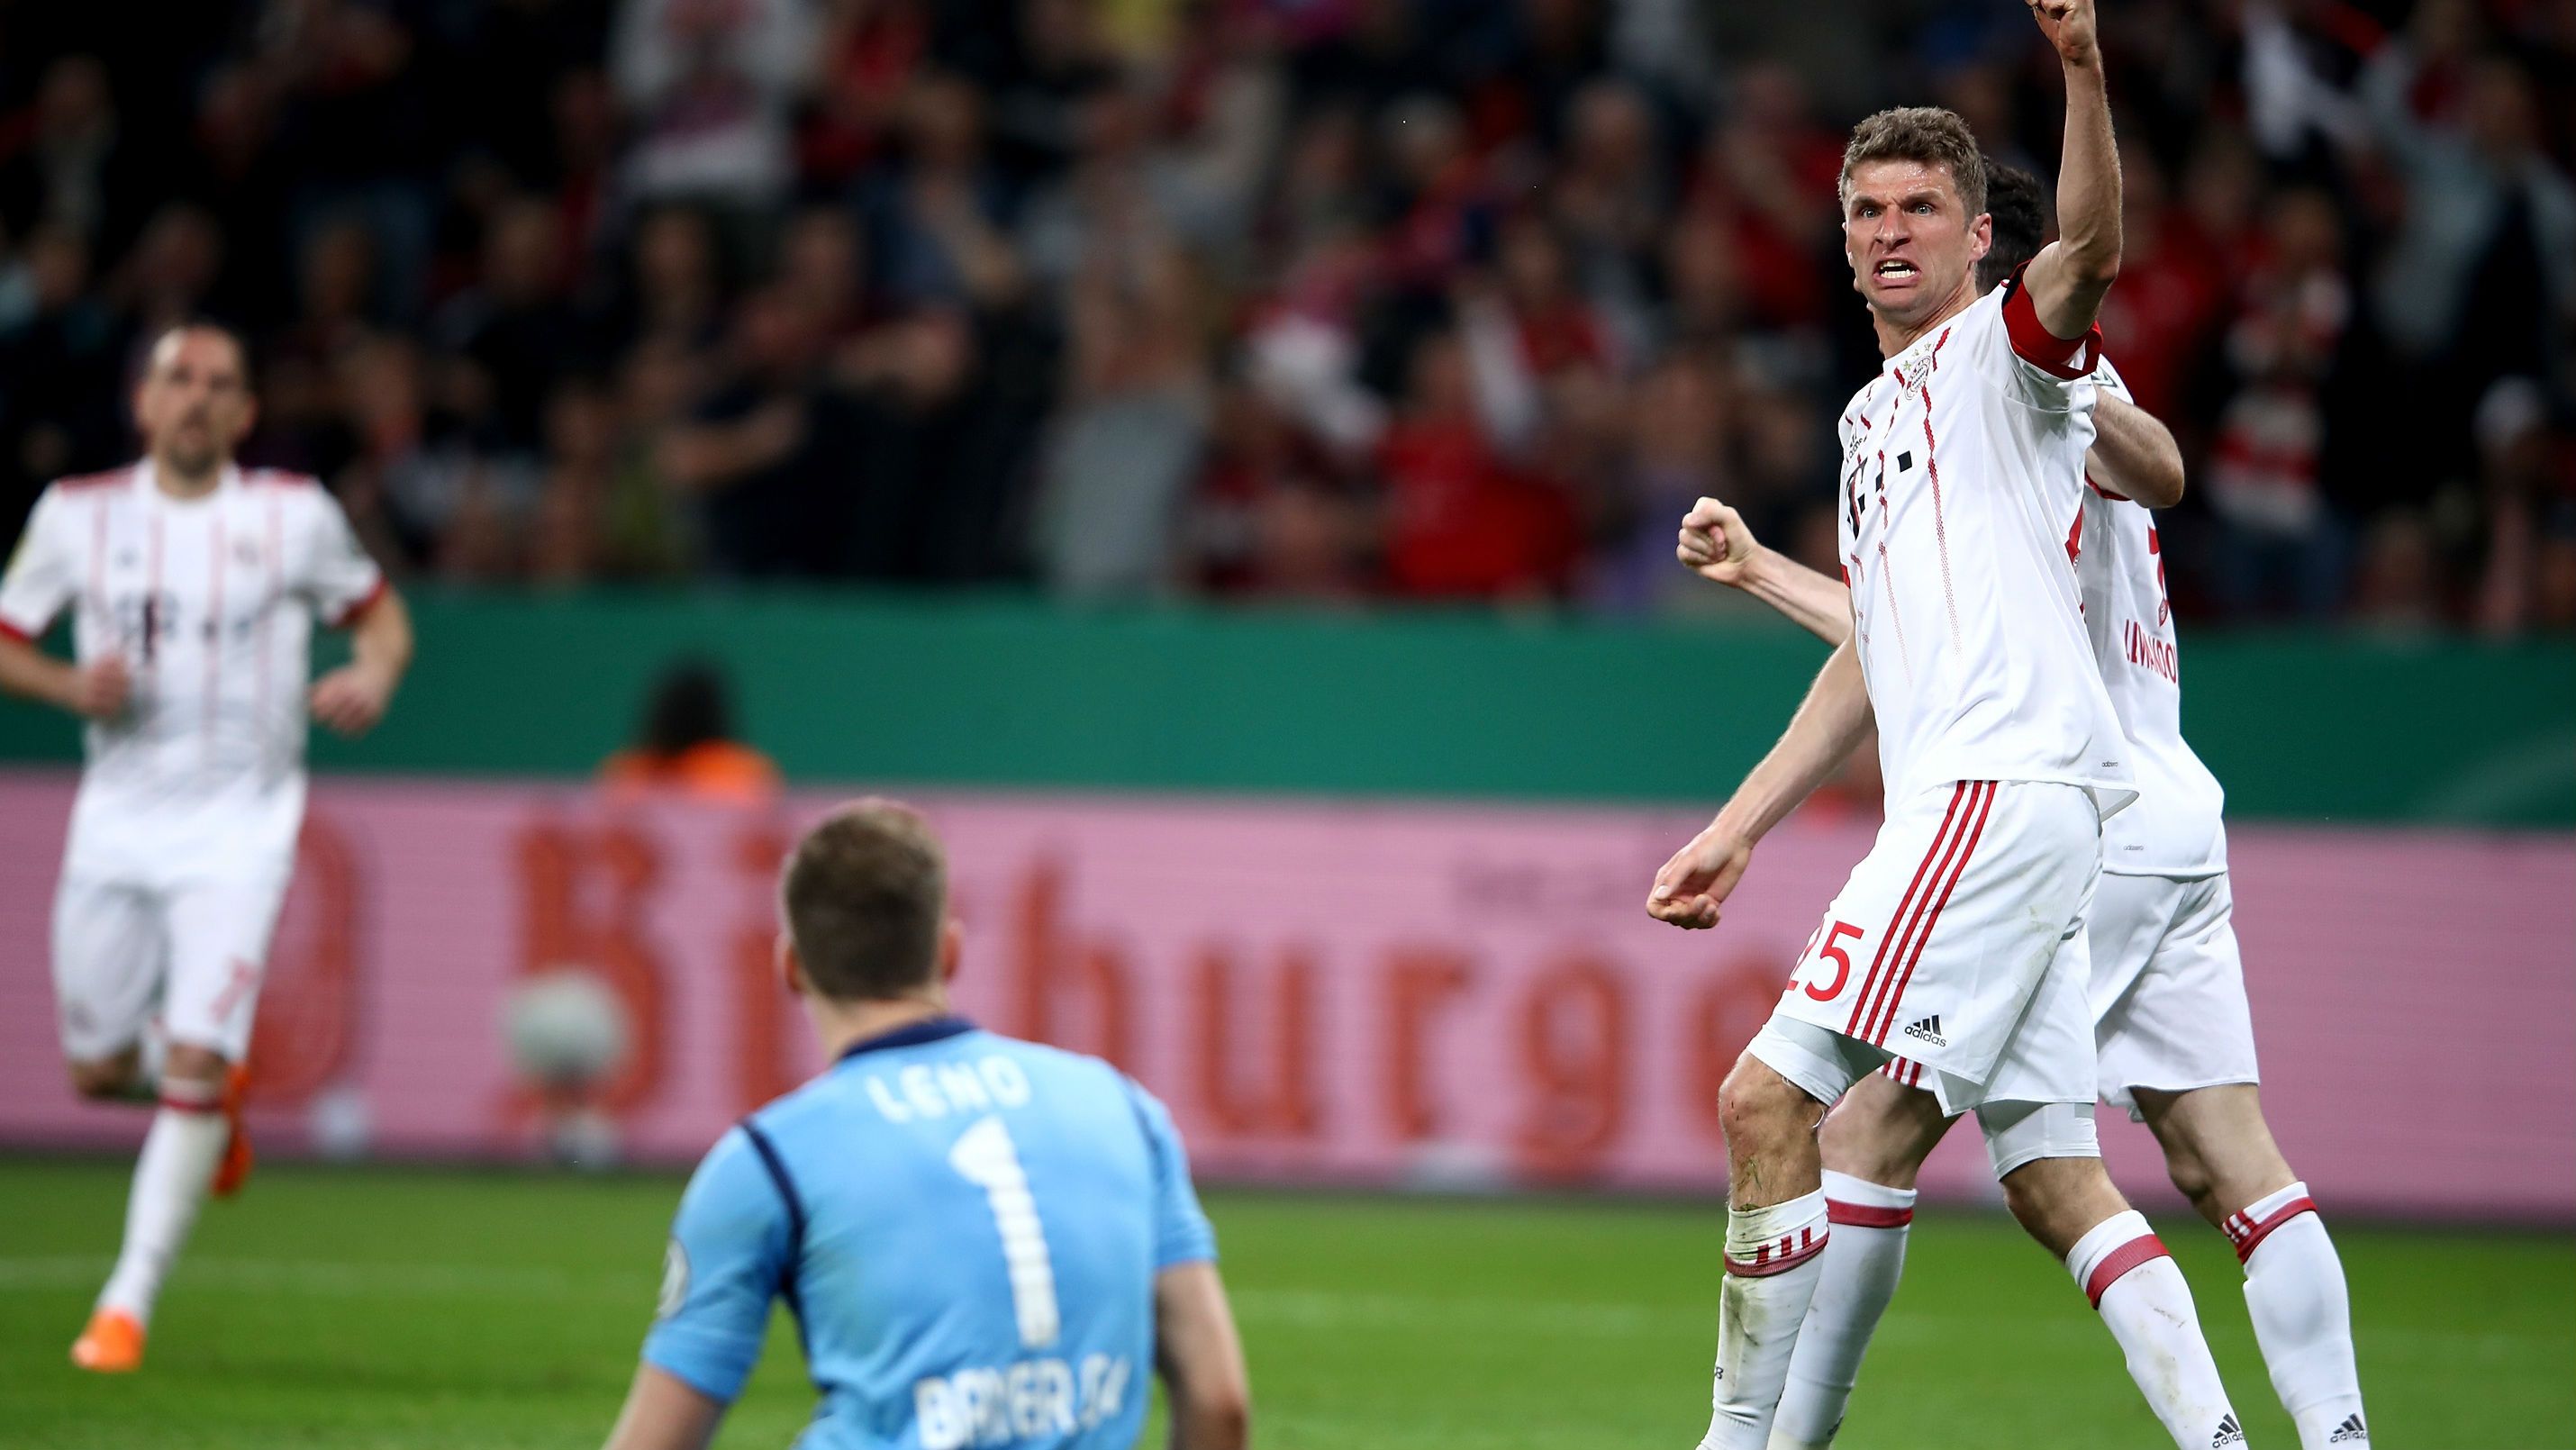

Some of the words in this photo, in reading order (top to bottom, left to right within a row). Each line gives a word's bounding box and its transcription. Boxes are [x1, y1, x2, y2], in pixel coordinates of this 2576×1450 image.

[506, 815, 1794, 1182] Biburge
[1904, 1026, 1947, 1047] adidas
[866, 1056, 1031, 1124] LENO
[948, 1114, 1060, 1349] 1
